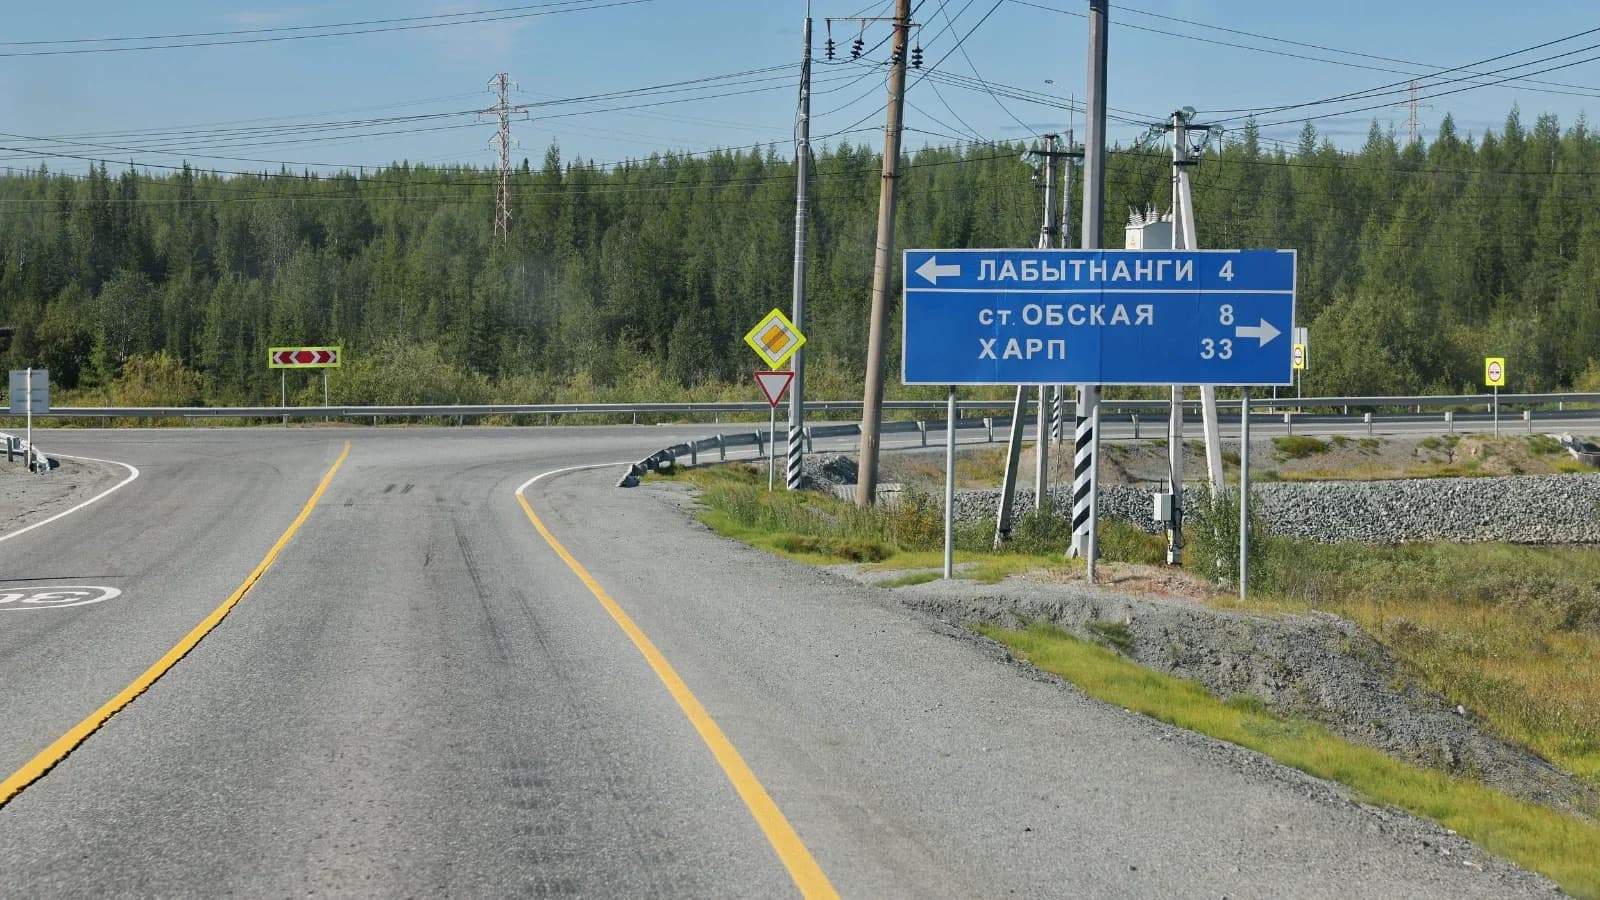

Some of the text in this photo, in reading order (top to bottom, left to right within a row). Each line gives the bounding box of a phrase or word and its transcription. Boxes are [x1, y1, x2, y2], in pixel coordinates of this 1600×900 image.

[977, 259, 1235, 282] ЛАБЫТНАНГИ 4
[1022, 303, 1154, 326] ОБСКАЯ
[1219, 304, 1235, 326] 8
[978, 338, 1233, 360] ХАРП 33
